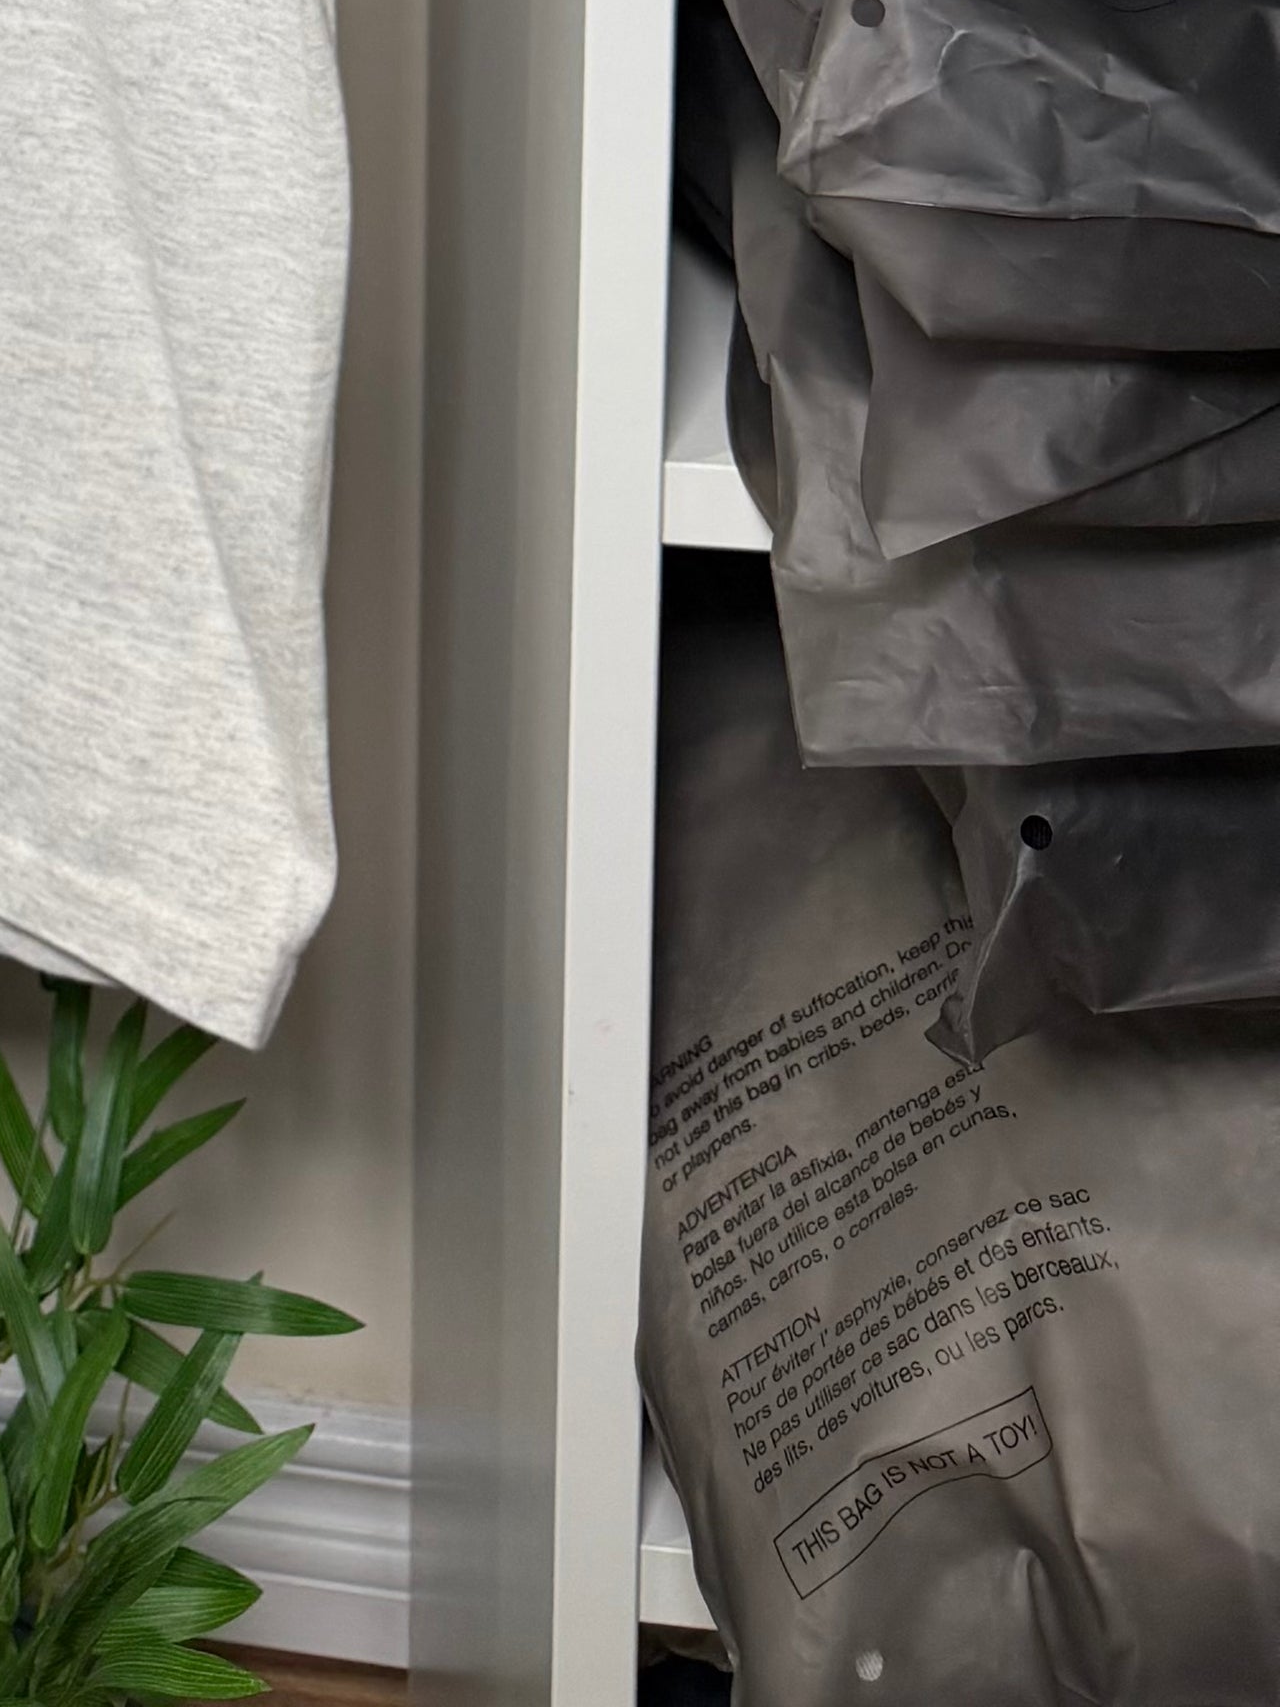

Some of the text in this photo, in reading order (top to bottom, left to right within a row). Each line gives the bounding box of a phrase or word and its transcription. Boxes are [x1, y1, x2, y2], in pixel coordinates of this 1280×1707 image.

[664, 1071, 705, 1108] avoid
[707, 1028, 764, 1076] danger
[770, 1013, 788, 1036] of
[897, 931, 940, 965] keep
[682, 1089, 720, 1123] away
[723, 1060, 762, 1090] from
[766, 1026, 828, 1064] babies
[832, 1001, 866, 1031] and
[653, 1142, 681, 1171] not
[684, 1116, 712, 1143] use
[714, 1095, 743, 1123] this
[746, 1074, 783, 1104] bag
[785, 1061, 802, 1081] in
[661, 1172, 680, 1193] or
[682, 1230, 721, 1264] Para
[723, 1193, 767, 1235] evitar
[771, 1181, 787, 1202] la
[855, 1085, 941, 1149] mantenga
[690, 1084, 982, 1290] bolsa fuera del alcance de bebés y
[676, 1145, 798, 1241] ADVENTENCIA
[749, 1248, 775, 1276] No
[779, 1213, 831, 1256] utilice
[835, 1189, 871, 1221] esta
[872, 1150, 918, 1193] bolsa
[922, 1133, 945, 1157] en
[833, 1236, 845, 1251] o
[721, 1307, 821, 1388] ATTENTION
[726, 1375, 767, 1414] Pour
[771, 1340, 816, 1384] éviter
[916, 1209, 1009, 1274] conservez
[1015, 1198, 1042, 1215] ce
[1048, 1187, 1091, 1208] sac
[733, 1215, 1111, 1439] hors de portée des bébés et des enfants.
[742, 1250, 1119, 1467] Ne pas utiliser ce sac dans les berceaux,
[754, 1461, 783, 1495] des
[817, 1408, 849, 1441] des
[935, 1341, 965, 1366] ou
[965, 1325, 1001, 1353] les
[1003, 1296, 1065, 1341] parcs.
[791, 1414, 1038, 1566] THIS BAG IS NOT A TOY!
